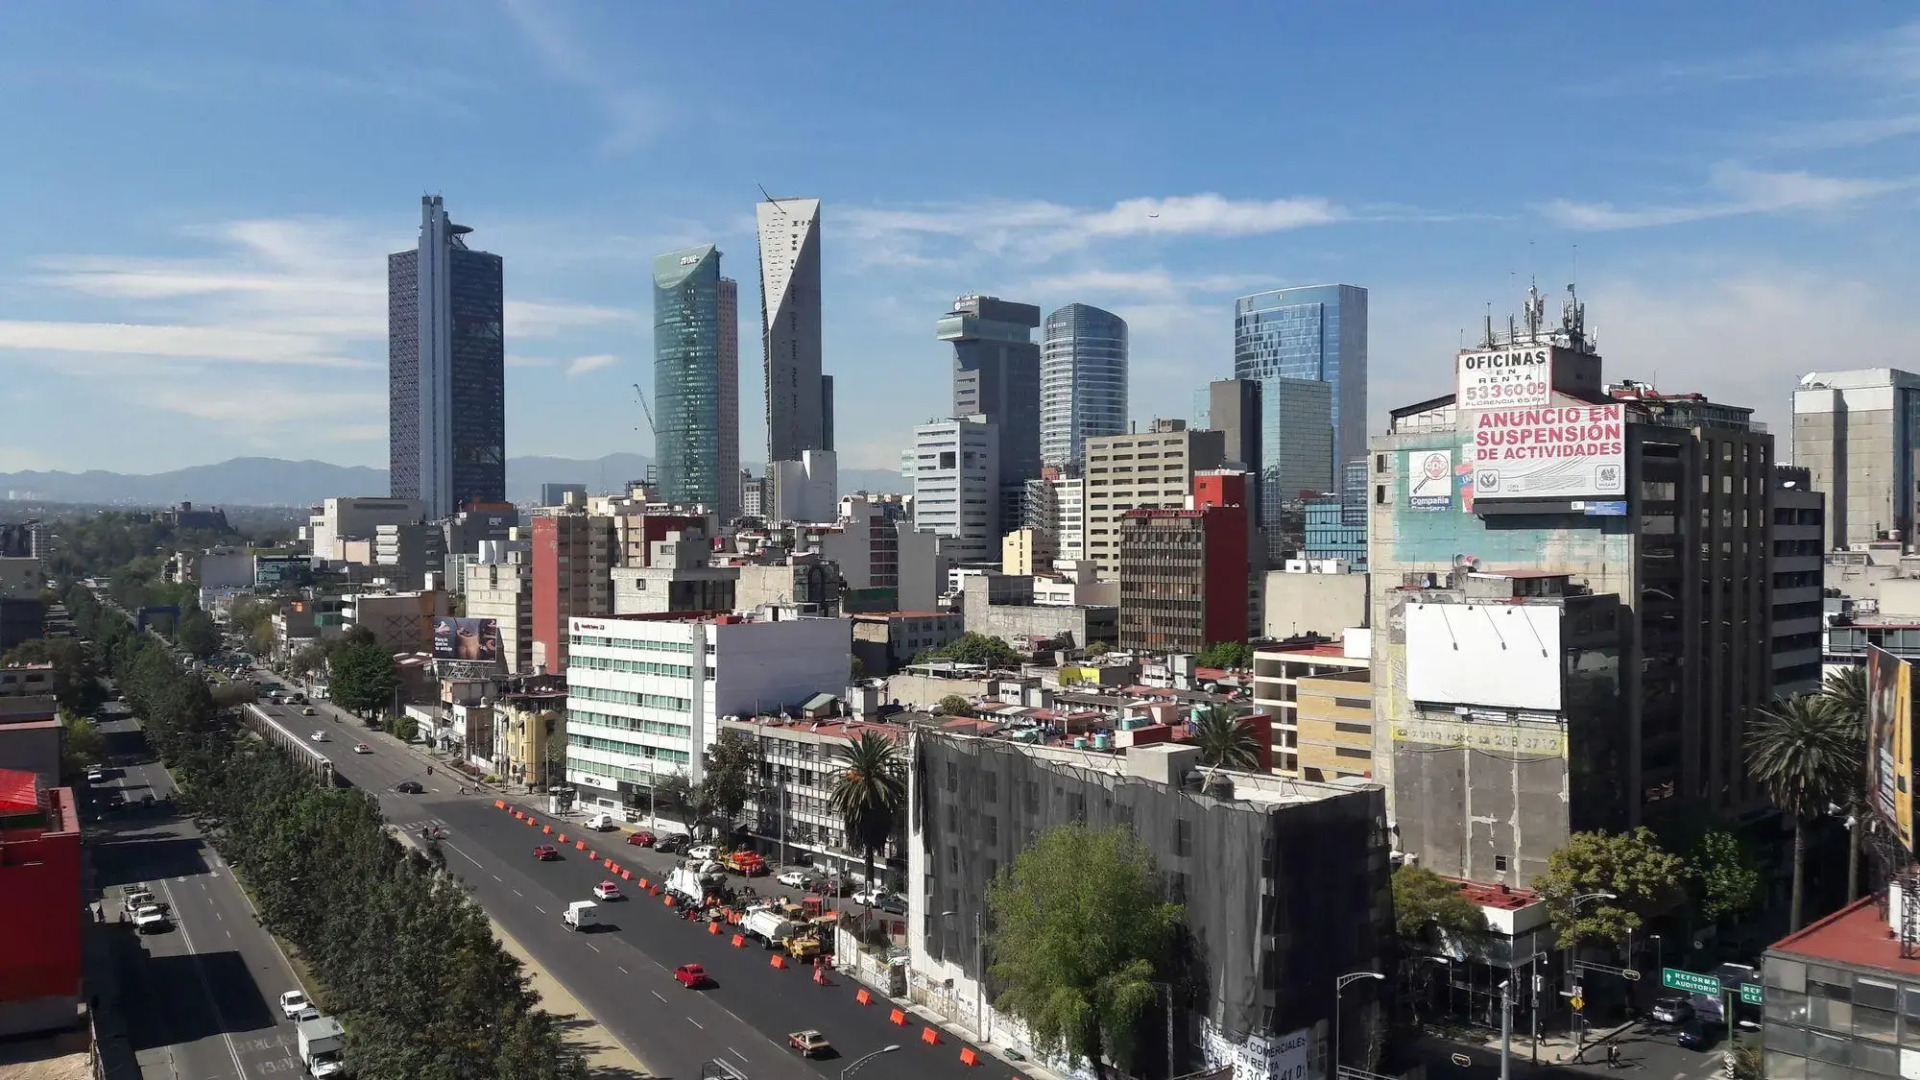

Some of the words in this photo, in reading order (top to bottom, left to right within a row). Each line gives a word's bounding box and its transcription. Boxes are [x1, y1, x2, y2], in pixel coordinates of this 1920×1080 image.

[1465, 351, 1546, 369] OFICINAS
[1478, 374, 1533, 384] RENTA
[1496, 368, 1516, 376] EN
[1478, 407, 1581, 429] ANUNCIO
[1588, 405, 1620, 422] EN
[1476, 420, 1620, 447] SUSPENSIÓN
[1476, 447, 1499, 461] DE
[1503, 441, 1622, 460] ACTIVIDADES
[1674, 972, 1717, 987] REFORMA
[1675, 979, 1718, 994] AUDITORIO
[1237, 1051, 1249, 1065] EN
[1251, 1056, 1279, 1073] RENTA
